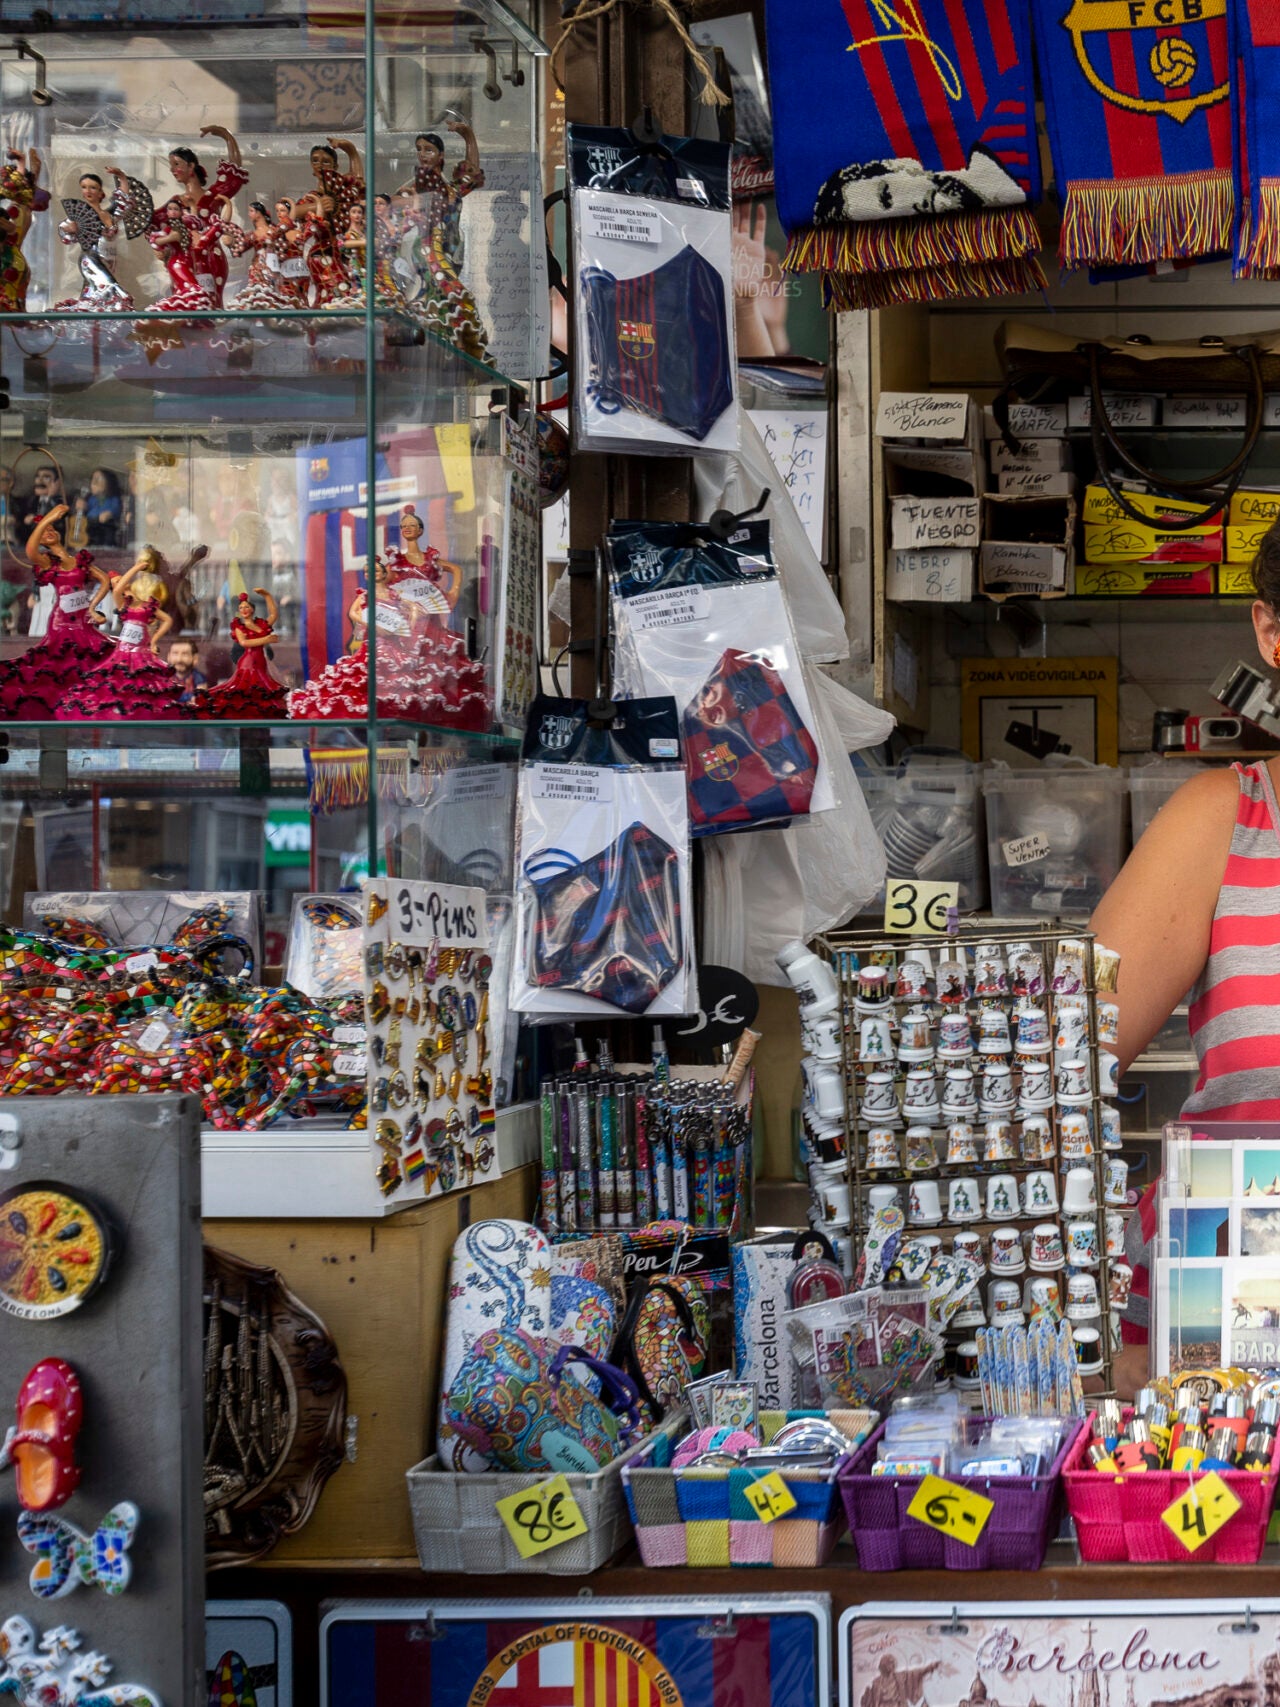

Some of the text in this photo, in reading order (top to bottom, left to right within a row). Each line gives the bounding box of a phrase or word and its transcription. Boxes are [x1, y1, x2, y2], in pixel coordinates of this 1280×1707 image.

[910, 396, 963, 417] Flamenco
[893, 413, 956, 432] Blanco
[901, 502, 978, 522] FUENTE
[915, 522, 977, 541] NEGRO
[895, 554, 950, 574] NEGRO
[629, 594, 665, 607] MASCARILLA
[968, 669, 1107, 683] ZONA VIDEOVIGILADA
[542, 766, 579, 777] MASCARILLA
[1007, 836, 1041, 856] SUPER
[622, 1253, 658, 1274] Pen
[499, 1626, 647, 1668] CAPITAL OF FOOTBALL
[976, 1626, 1221, 1677] Barcelona
[471, 1674, 495, 1707] 1899
[653, 1671, 678, 1706] 1899
